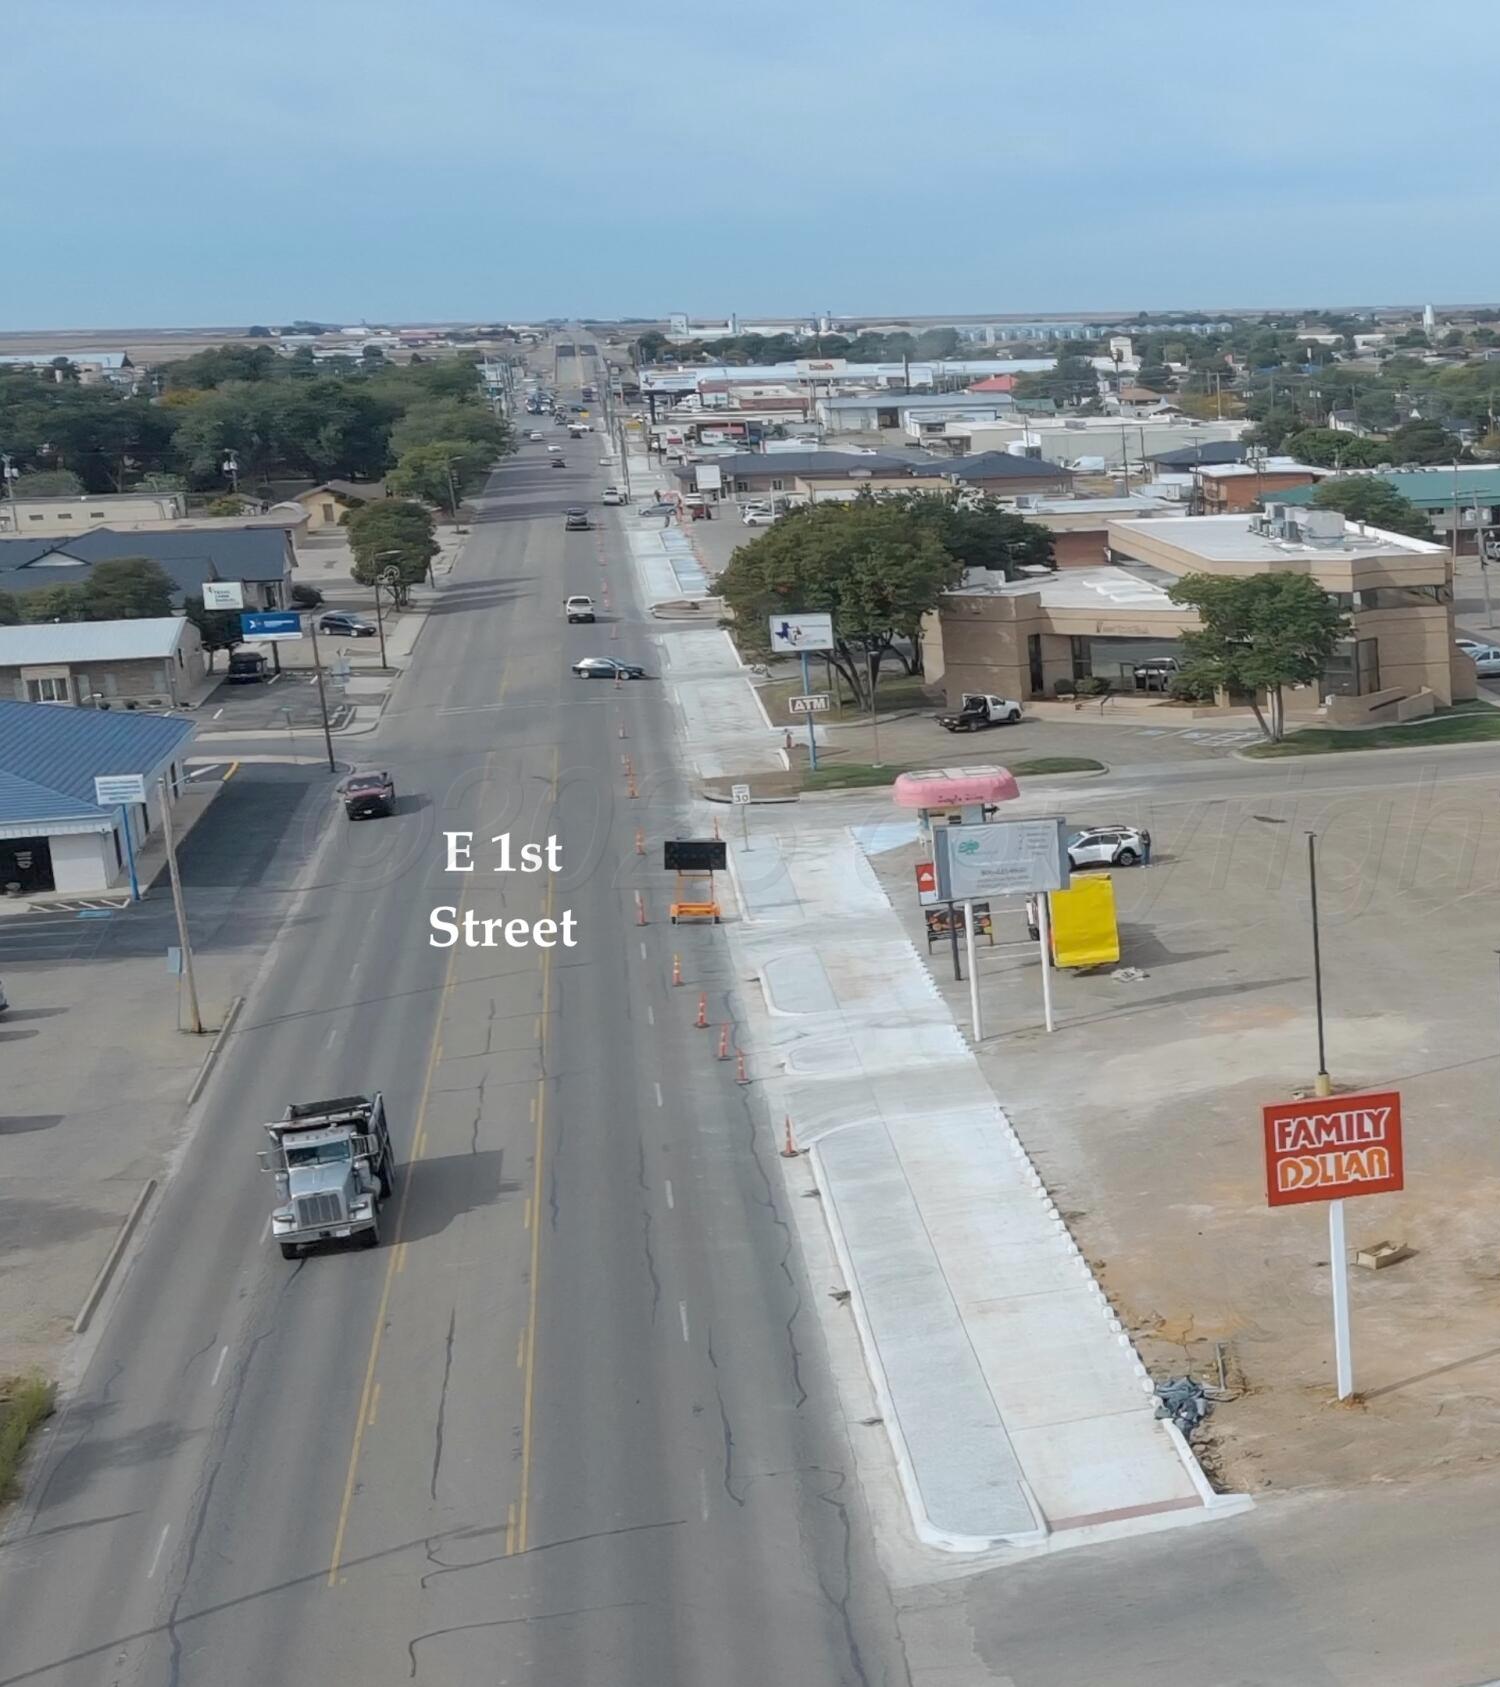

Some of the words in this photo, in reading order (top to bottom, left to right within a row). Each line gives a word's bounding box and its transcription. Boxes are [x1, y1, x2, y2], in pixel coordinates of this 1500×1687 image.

[793, 698, 826, 711] ATM
[735, 794, 749, 803] 30
[1274, 1107, 1391, 1153] FAMILY
[1276, 1146, 1390, 1192] DOLLAR
